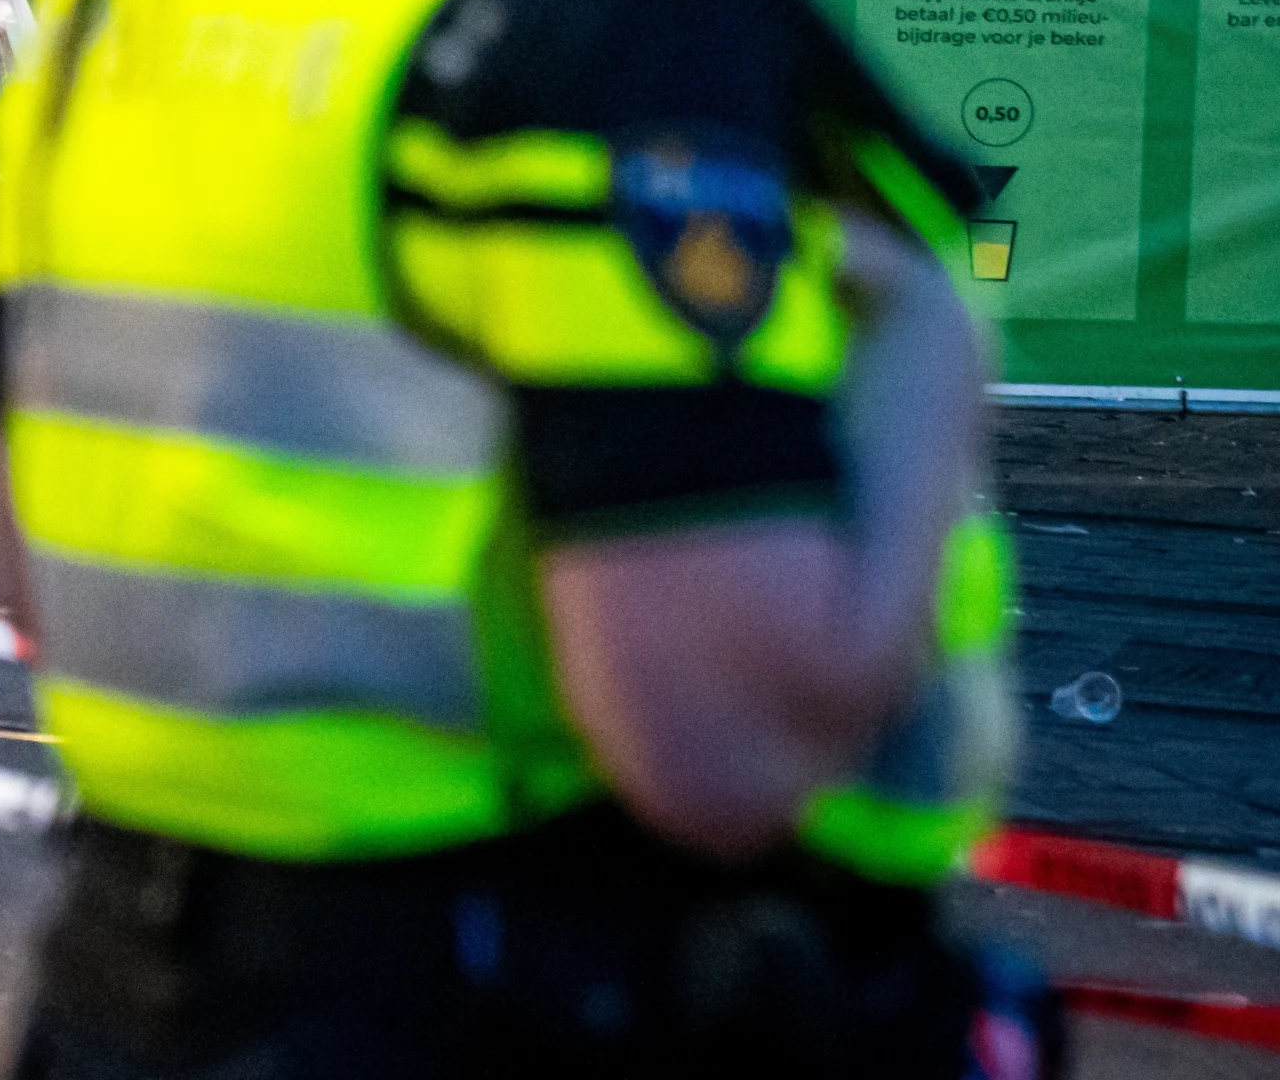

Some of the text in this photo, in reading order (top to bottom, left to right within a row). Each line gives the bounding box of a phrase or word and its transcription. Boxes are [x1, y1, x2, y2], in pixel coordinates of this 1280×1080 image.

[895, 6, 1109, 25] betaal je €0,50 milieu-
[1228, 11, 1260, 27] bar
[896, 28, 1106, 48] bijdrage voor je beker
[975, 105, 1021, 124] 0,50
